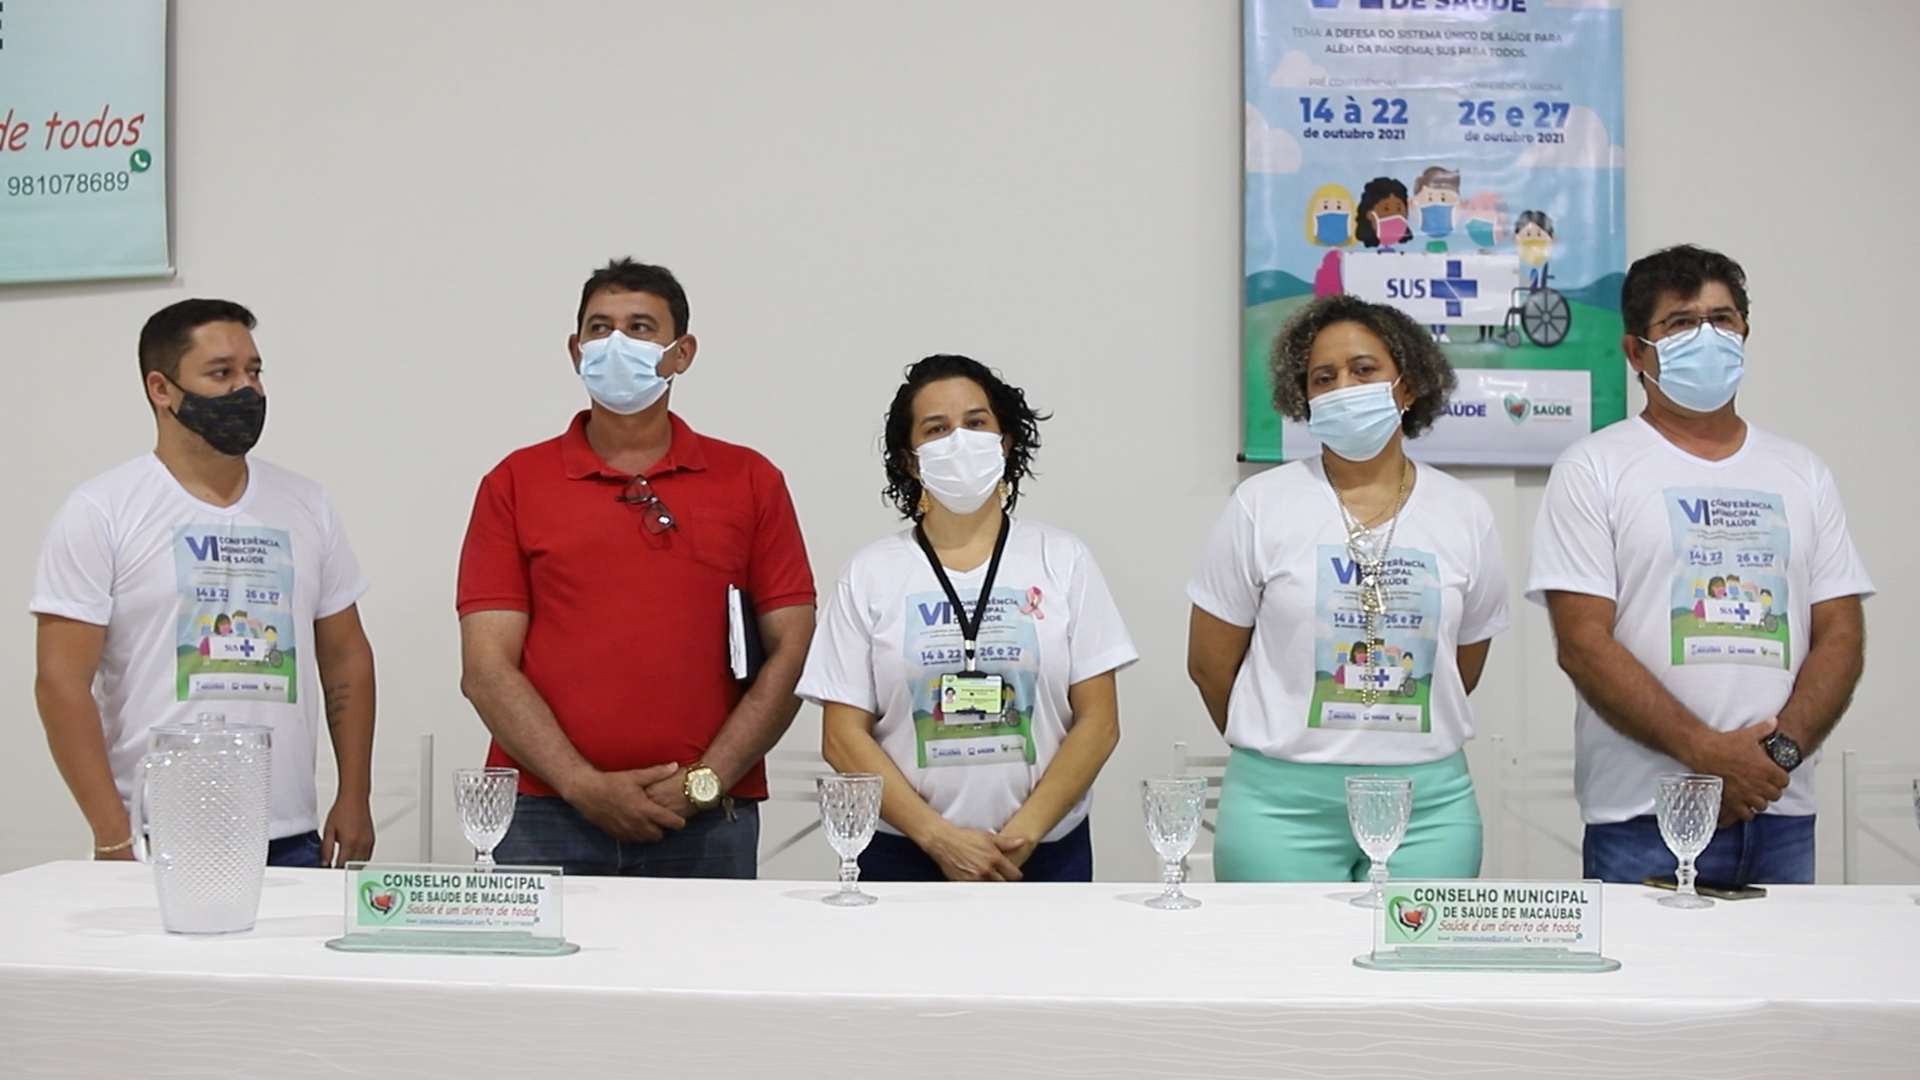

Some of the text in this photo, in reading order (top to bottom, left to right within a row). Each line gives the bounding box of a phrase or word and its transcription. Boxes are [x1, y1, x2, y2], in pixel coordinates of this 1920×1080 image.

[1325, 28, 1333, 38] A
[1335, 28, 1376, 38] DEFESA
[1378, 29, 1395, 39] DO
[1398, 29, 1441, 39] SISTEMA
[1443, 29, 1478, 40] ÚNICO
[1481, 31, 1495, 41] DE
[1497, 31, 1532, 42] SAÚDE
[1534, 33, 1563, 42] PARA
[1325, 43, 1354, 53] ALÉM
[1357, 44, 1372, 53] DA
[1436, 46, 1457, 55] SUS
[1459, 46, 1487, 56] PARA
[1490, 47, 1528, 57] TODOS.
[1299, 95, 1408, 124] 14 à 22
[1458, 100, 1570, 128] 26 e 27
[45, 104, 145, 150] todos
[1303, 127, 1405, 140] de outubro 2021
[1464, 131, 1565, 143] de outubro 2021
[7, 171, 130, 196] 981078689
[1387, 278, 1426, 299] SUS
[1441, 400, 1486, 417] AÚDE
[1532, 402, 1572, 416] SAÚDE
[1677, 498, 1711, 526] VI
[1710, 499, 1773, 511] CONFERÊNCIA
[1712, 509, 1761, 518] MUNICIPAL
[1713, 517, 1757, 527] DE SAÚDE
[184, 535, 219, 561] VI
[219, 536, 281, 548] CONFERÊNCIA
[220, 546, 268, 555] MUNICIPAL
[1690, 551, 1701, 560] 14
[1710, 551, 1723, 561] 22
[221, 555, 231, 564] DE
[1737, 553, 1750, 563] 26
[1763, 553, 1775, 563] 27
[1330, 557, 1362, 586] VI
[196, 587, 207, 597] 14
[219, 588, 229, 599] 22
[245, 589, 258, 599] 26
[268, 591, 280, 601] 27
[918, 602, 951, 626] VI
[1334, 613, 1345, 622] 14
[1385, 615, 1398, 624] 26
[1410, 615, 1423, 625] 27
[921, 651, 934, 660] 14
[947, 649, 962, 659] 22
[980, 647, 994, 656] 26
[1007, 646, 1021, 657] 27
[383, 874, 545, 890] CONSELHO MUNICIPAL
[410, 889, 539, 905] DE SAÚDE DE MACAÚBAS
[1414, 888, 1588, 904] CONSELHO MUNICIPAL
[406, 902, 539, 917] Saúde é um direito de todos
[1443, 904, 1582, 920] DE SAÚDE DE MACAÚBAS
[1438, 919, 1582, 934] Saúde é um direito de todos
